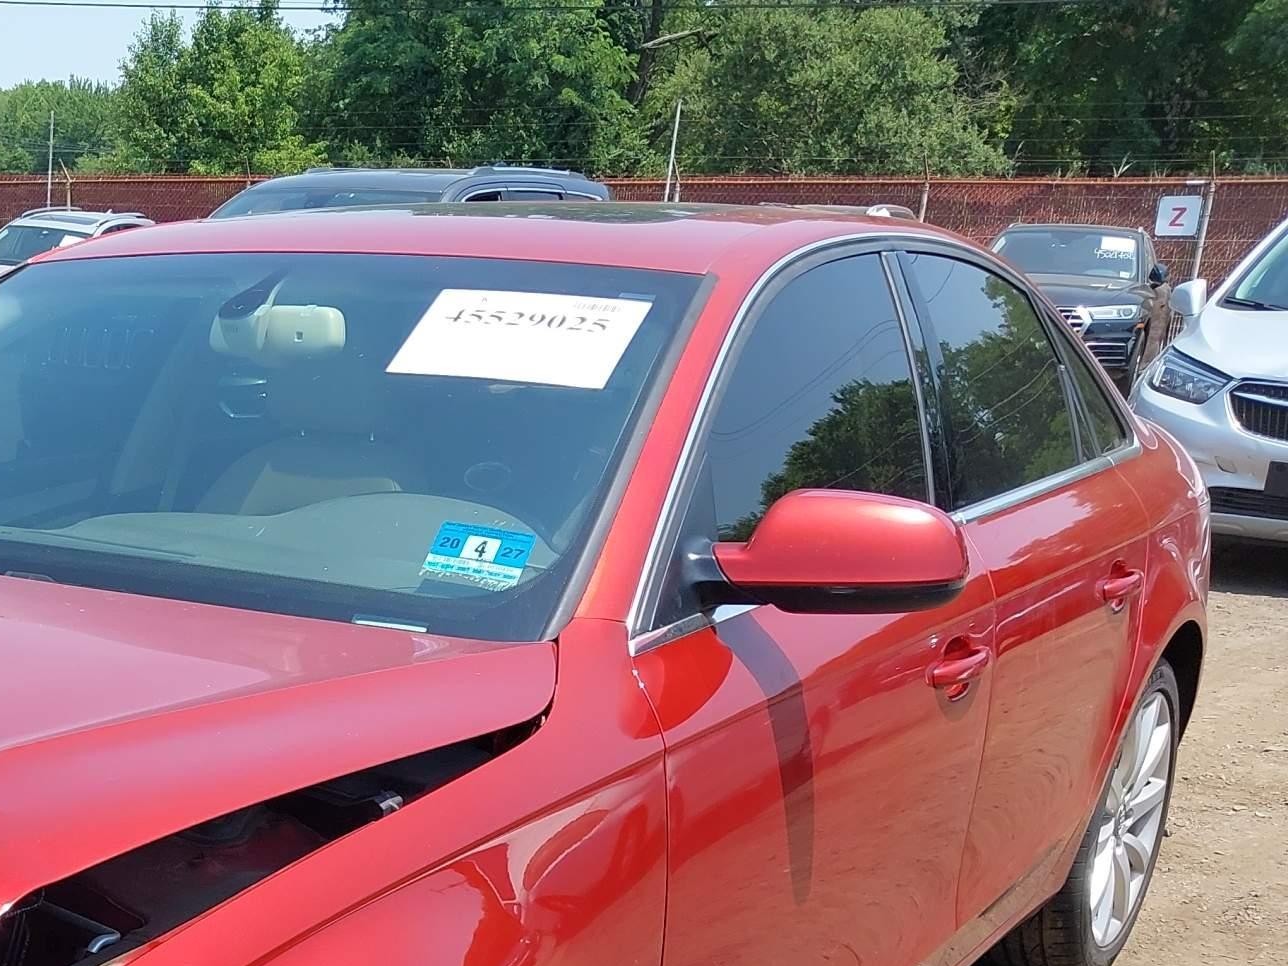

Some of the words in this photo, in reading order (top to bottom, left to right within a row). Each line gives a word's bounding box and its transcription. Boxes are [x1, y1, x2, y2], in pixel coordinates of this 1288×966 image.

[1169, 208, 1187, 226] Z
[446, 309, 610, 332] 45529025
[439, 536, 461, 550] 20
[474, 540, 489, 559] 4
[500, 546, 525, 560] 27
